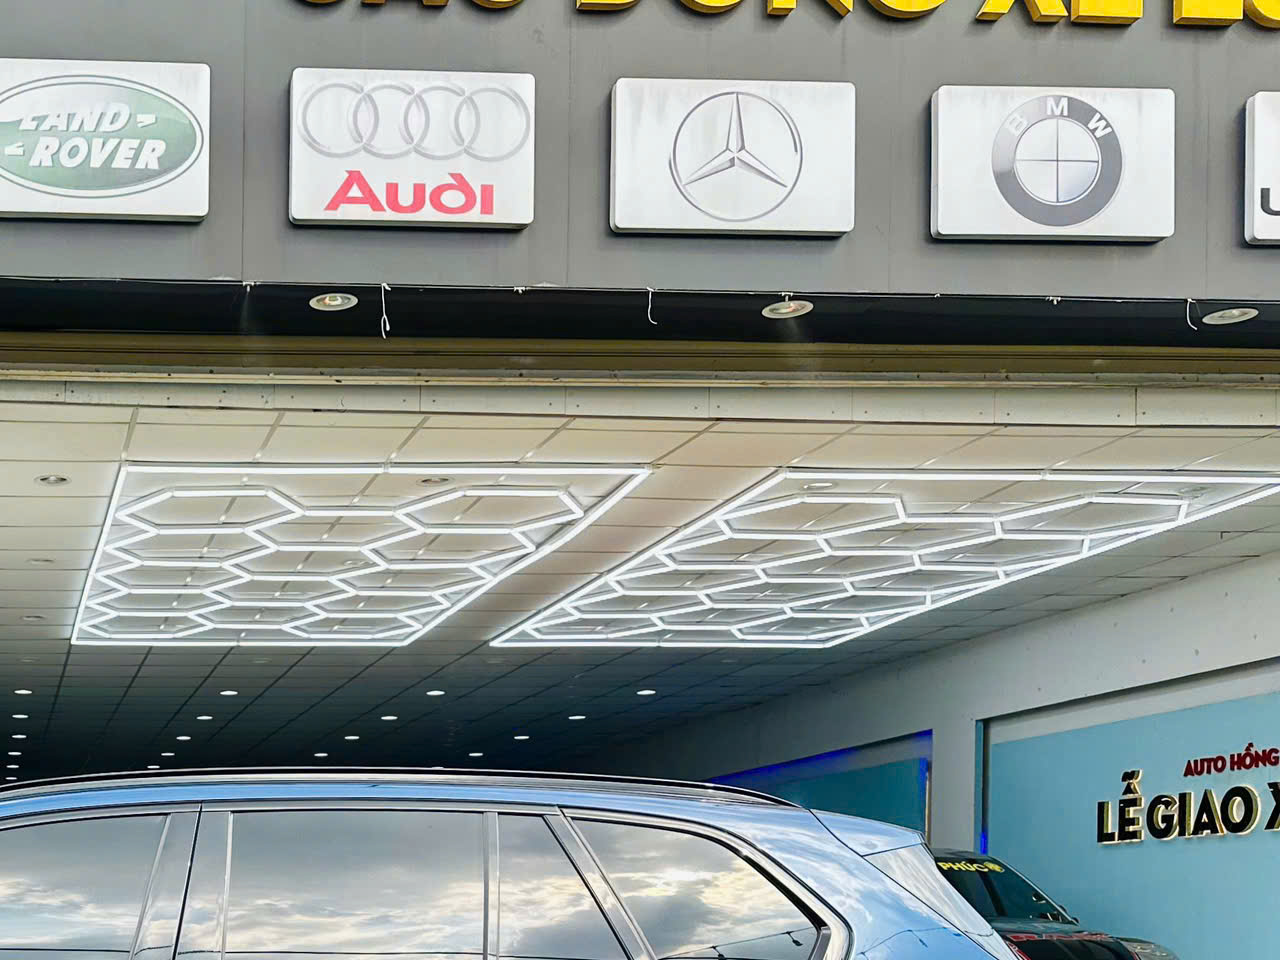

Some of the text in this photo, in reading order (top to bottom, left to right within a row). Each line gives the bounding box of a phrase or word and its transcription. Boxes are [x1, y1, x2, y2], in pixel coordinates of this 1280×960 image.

[19, 102, 132, 132] LAND
[1005, 96, 1113, 139] BMW
[28, 136, 167, 170] ROVER
[323, 169, 494, 215] Audi
[1183, 742, 1280, 777] AUTO HỒNG
[1096, 768, 1144, 844] LỄ
[1146, 784, 1262, 841] GIAO
[937, 860, 989, 873] PHÚC
